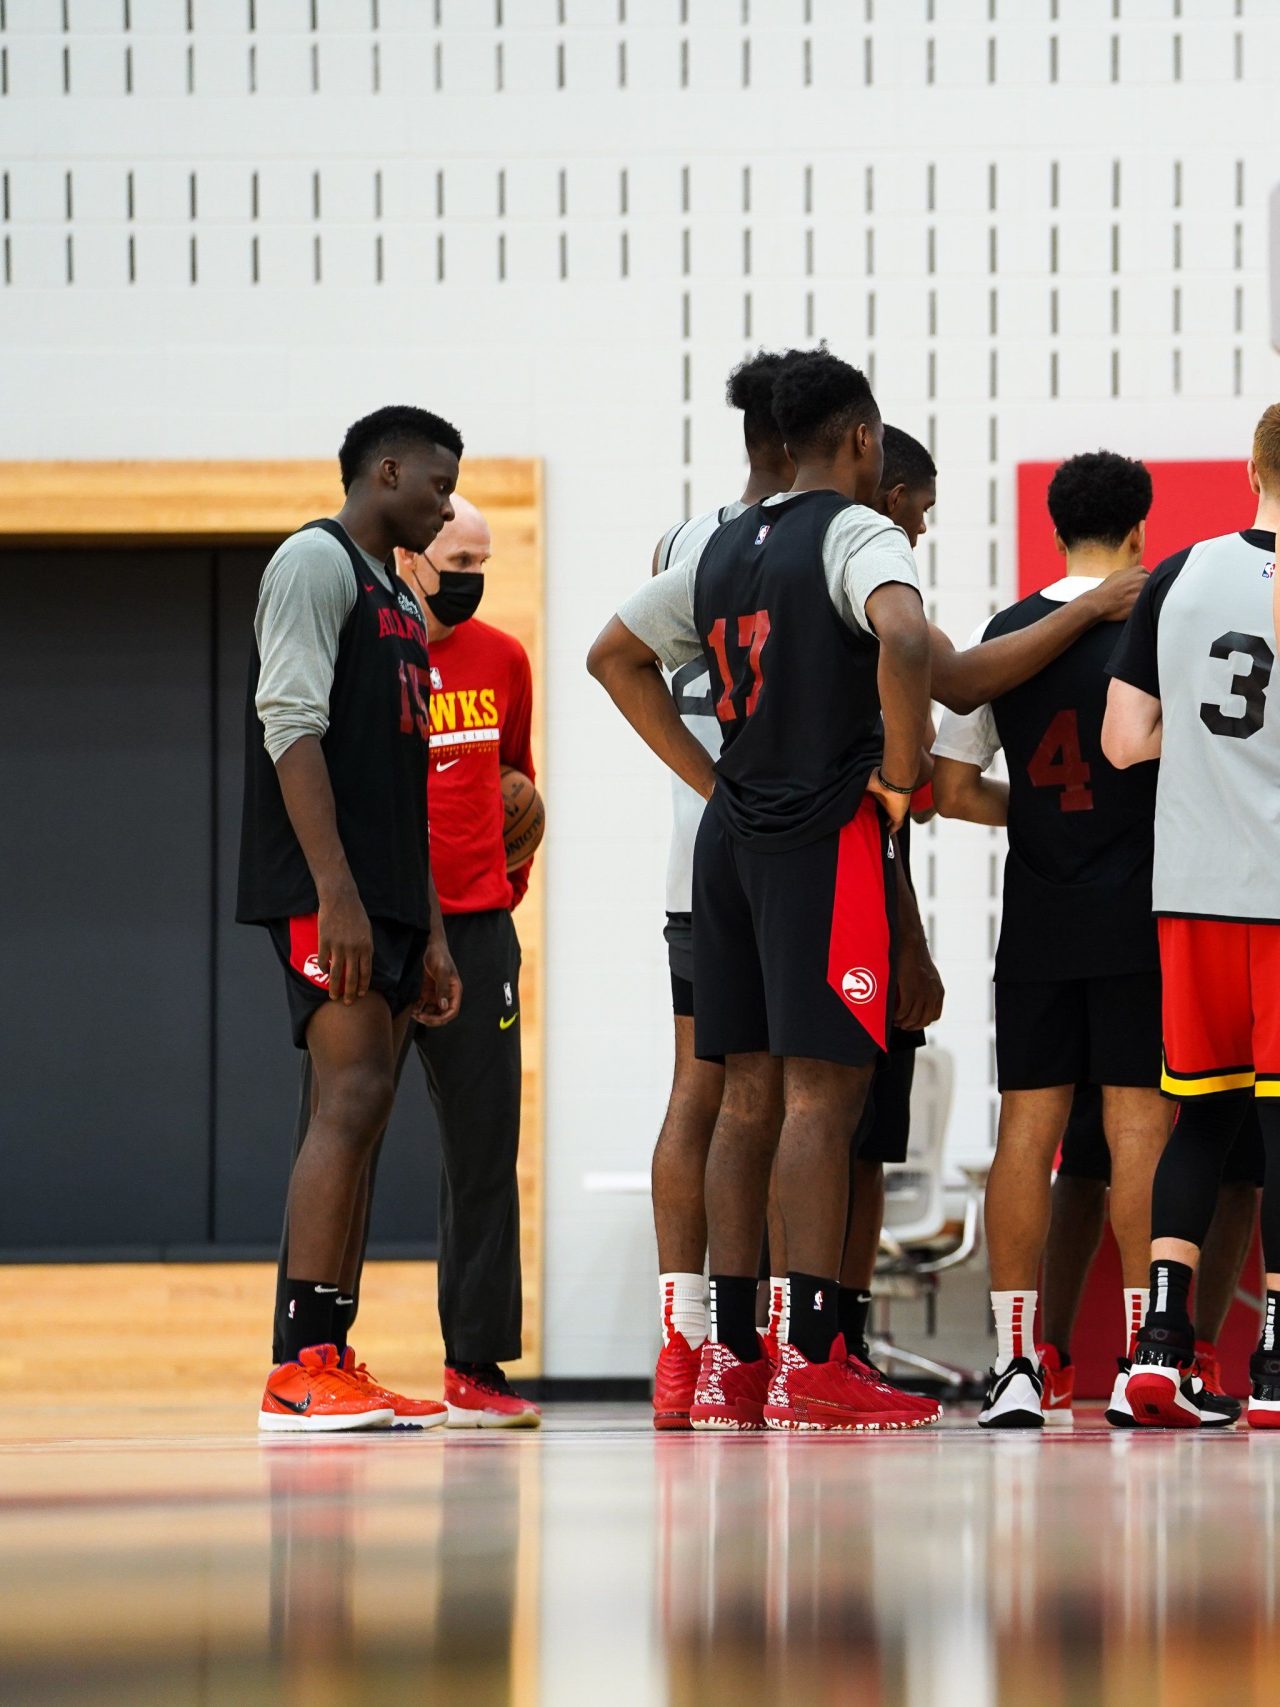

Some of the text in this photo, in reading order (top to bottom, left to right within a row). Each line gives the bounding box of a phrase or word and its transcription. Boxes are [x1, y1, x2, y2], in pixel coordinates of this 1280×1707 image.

[429, 688, 499, 732] WKS
[707, 609, 771, 722] 17
[1200, 632, 1274, 739] 3
[1028, 710, 1092, 811] 4
